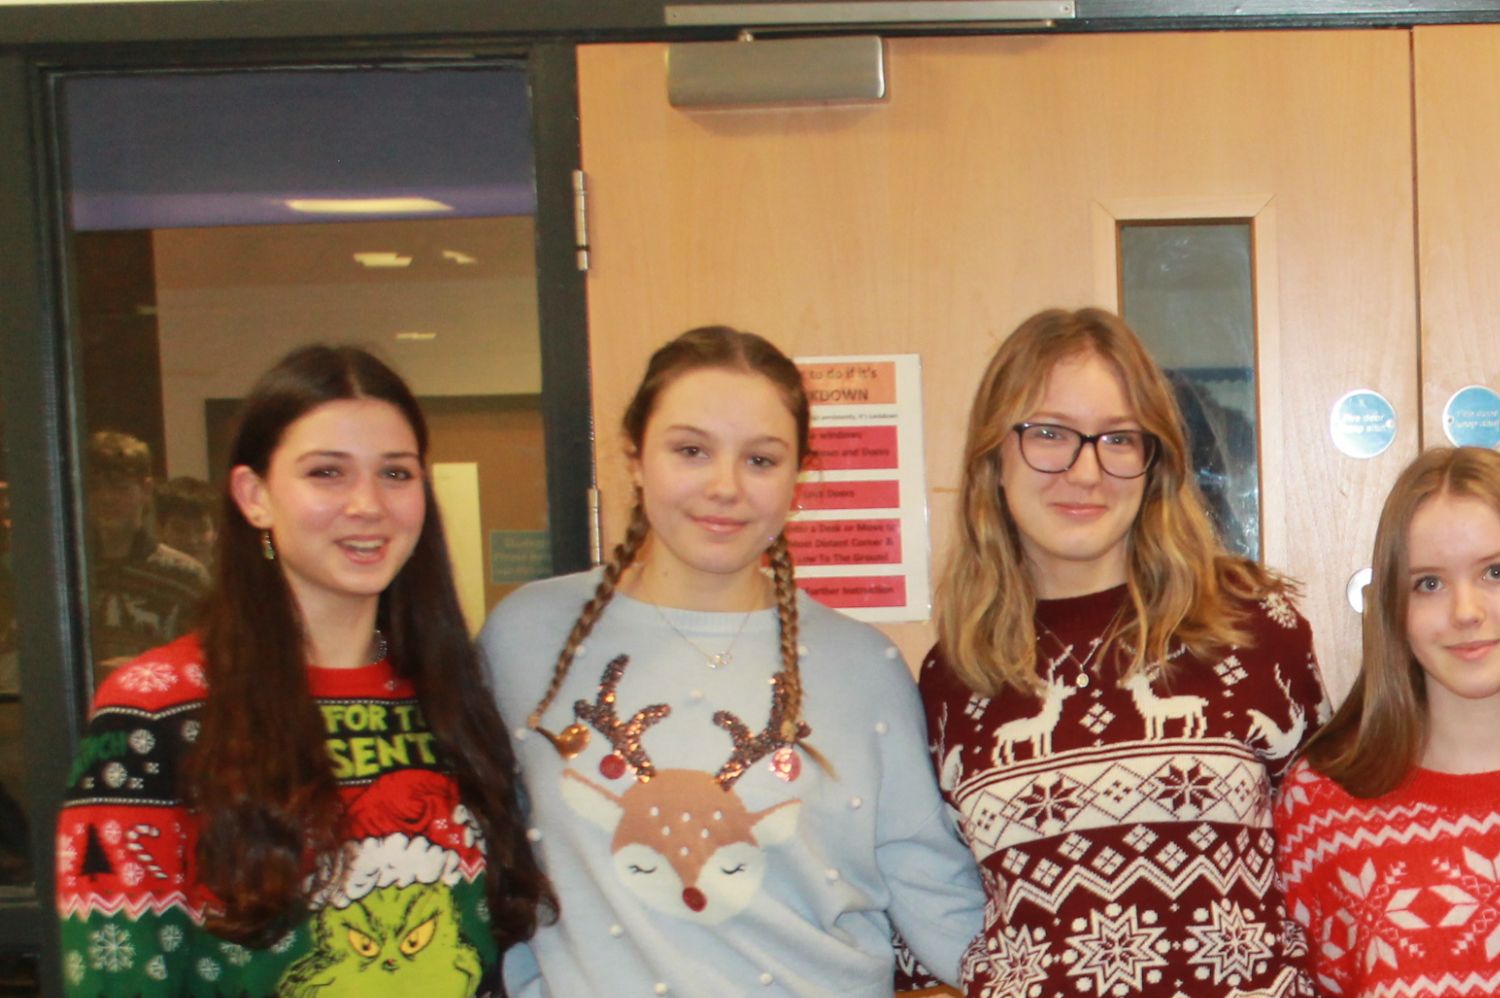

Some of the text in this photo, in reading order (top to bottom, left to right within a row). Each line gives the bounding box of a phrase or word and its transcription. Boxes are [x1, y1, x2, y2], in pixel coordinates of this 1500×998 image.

[827, 368, 842, 379] do
[807, 388, 869, 401] KDOWN
[320, 704, 389, 734] FOR
